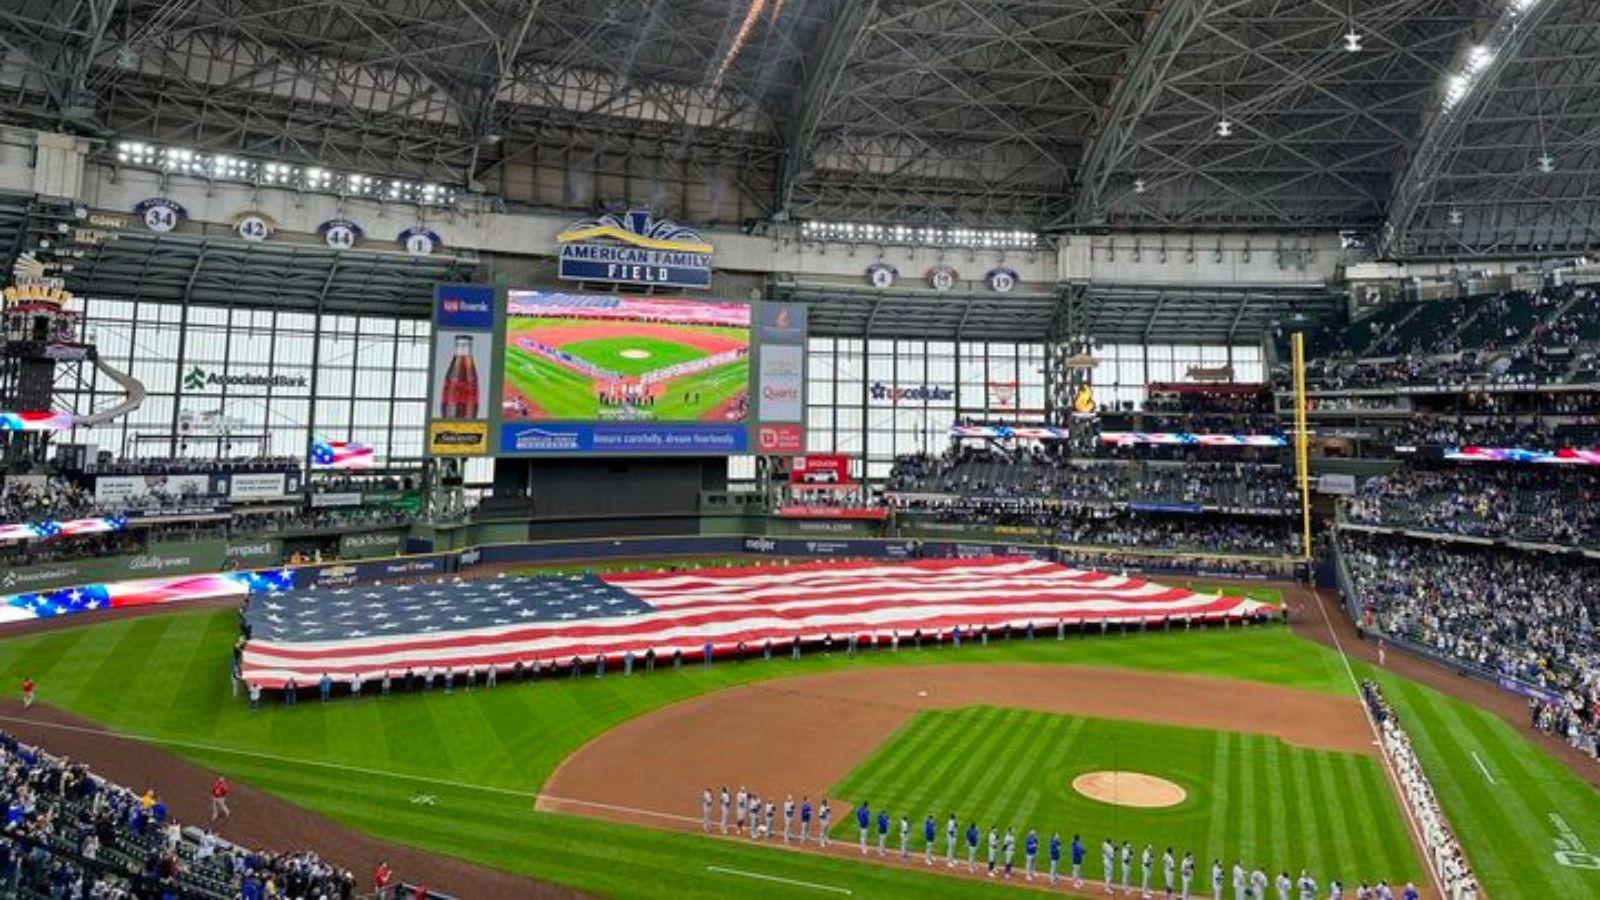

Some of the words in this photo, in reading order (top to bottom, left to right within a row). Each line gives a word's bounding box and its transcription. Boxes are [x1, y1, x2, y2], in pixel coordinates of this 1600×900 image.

[148, 211, 173, 226] 34
[242, 223, 264, 236] 42
[331, 232, 351, 244] 44
[563, 245, 648, 263] AMERICAN
[655, 253, 711, 267] FAMILY
[607, 264, 668, 281] FIELD
[763, 387, 799, 401] Quartz
